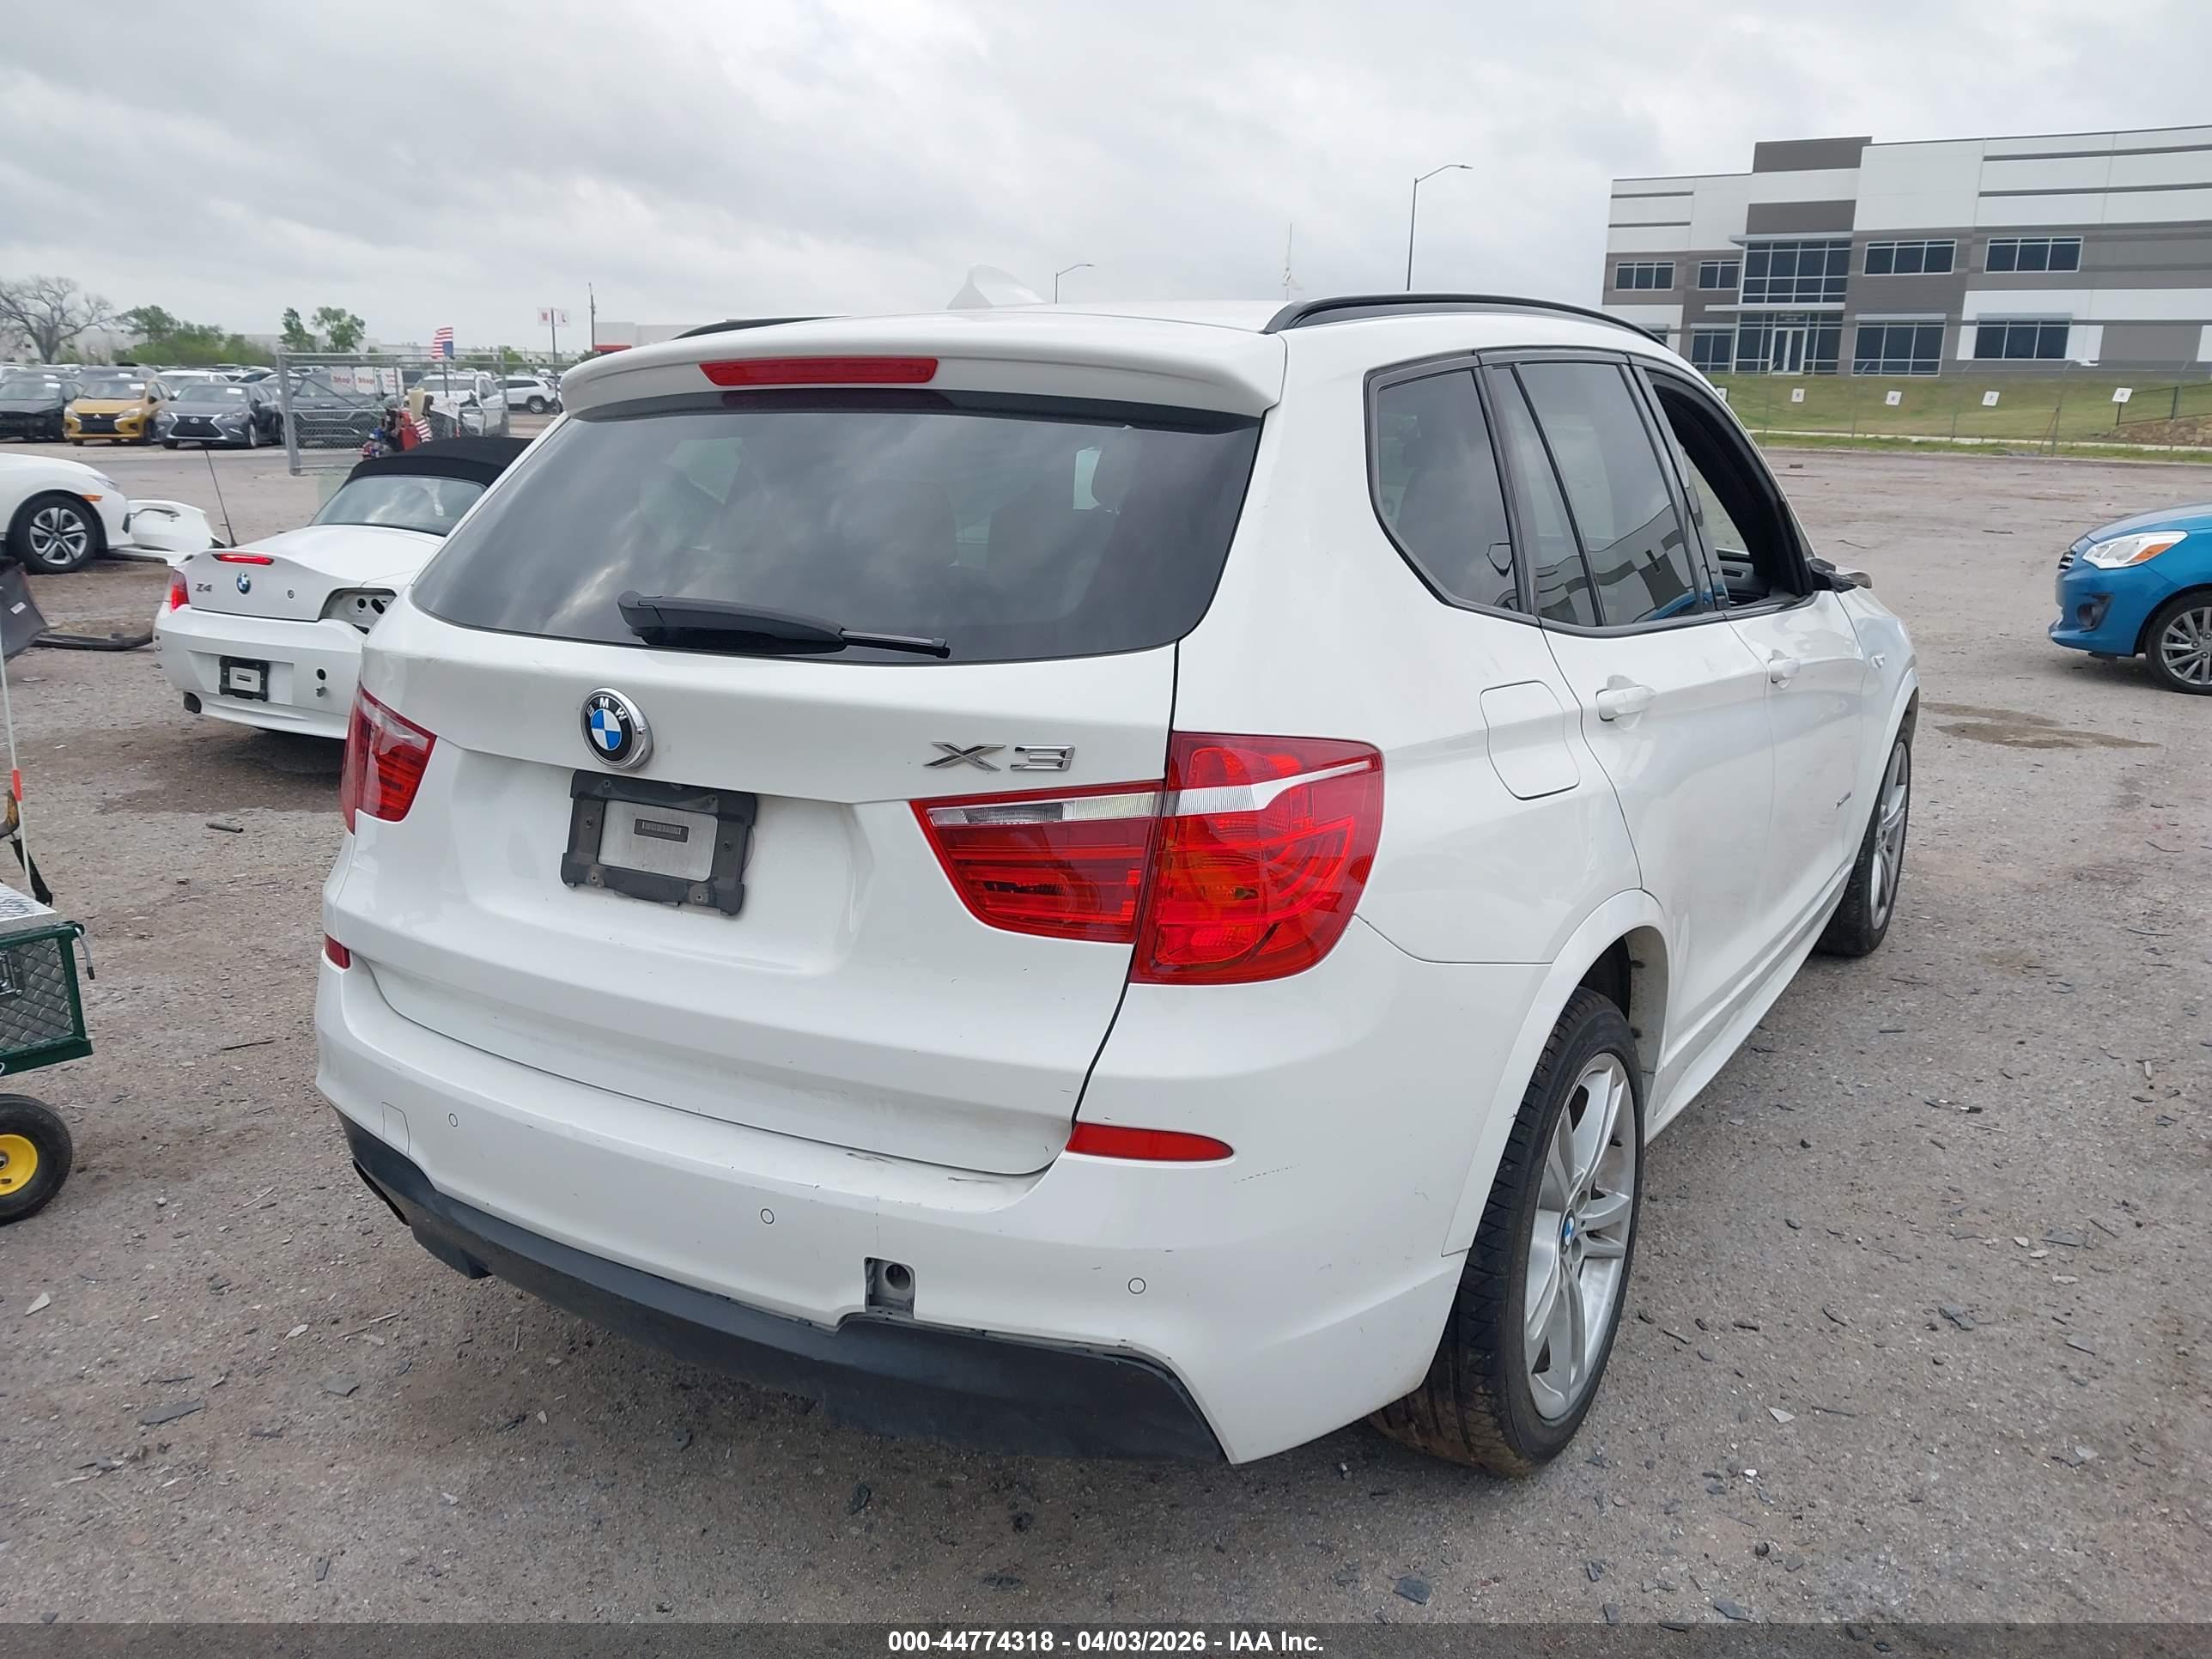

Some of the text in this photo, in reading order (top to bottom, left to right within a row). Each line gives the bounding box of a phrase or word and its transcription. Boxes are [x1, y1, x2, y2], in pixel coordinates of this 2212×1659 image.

[196, 583, 213, 592] Z4
[586, 696, 628, 721] BMW
[923, 741, 1076, 773] X3
